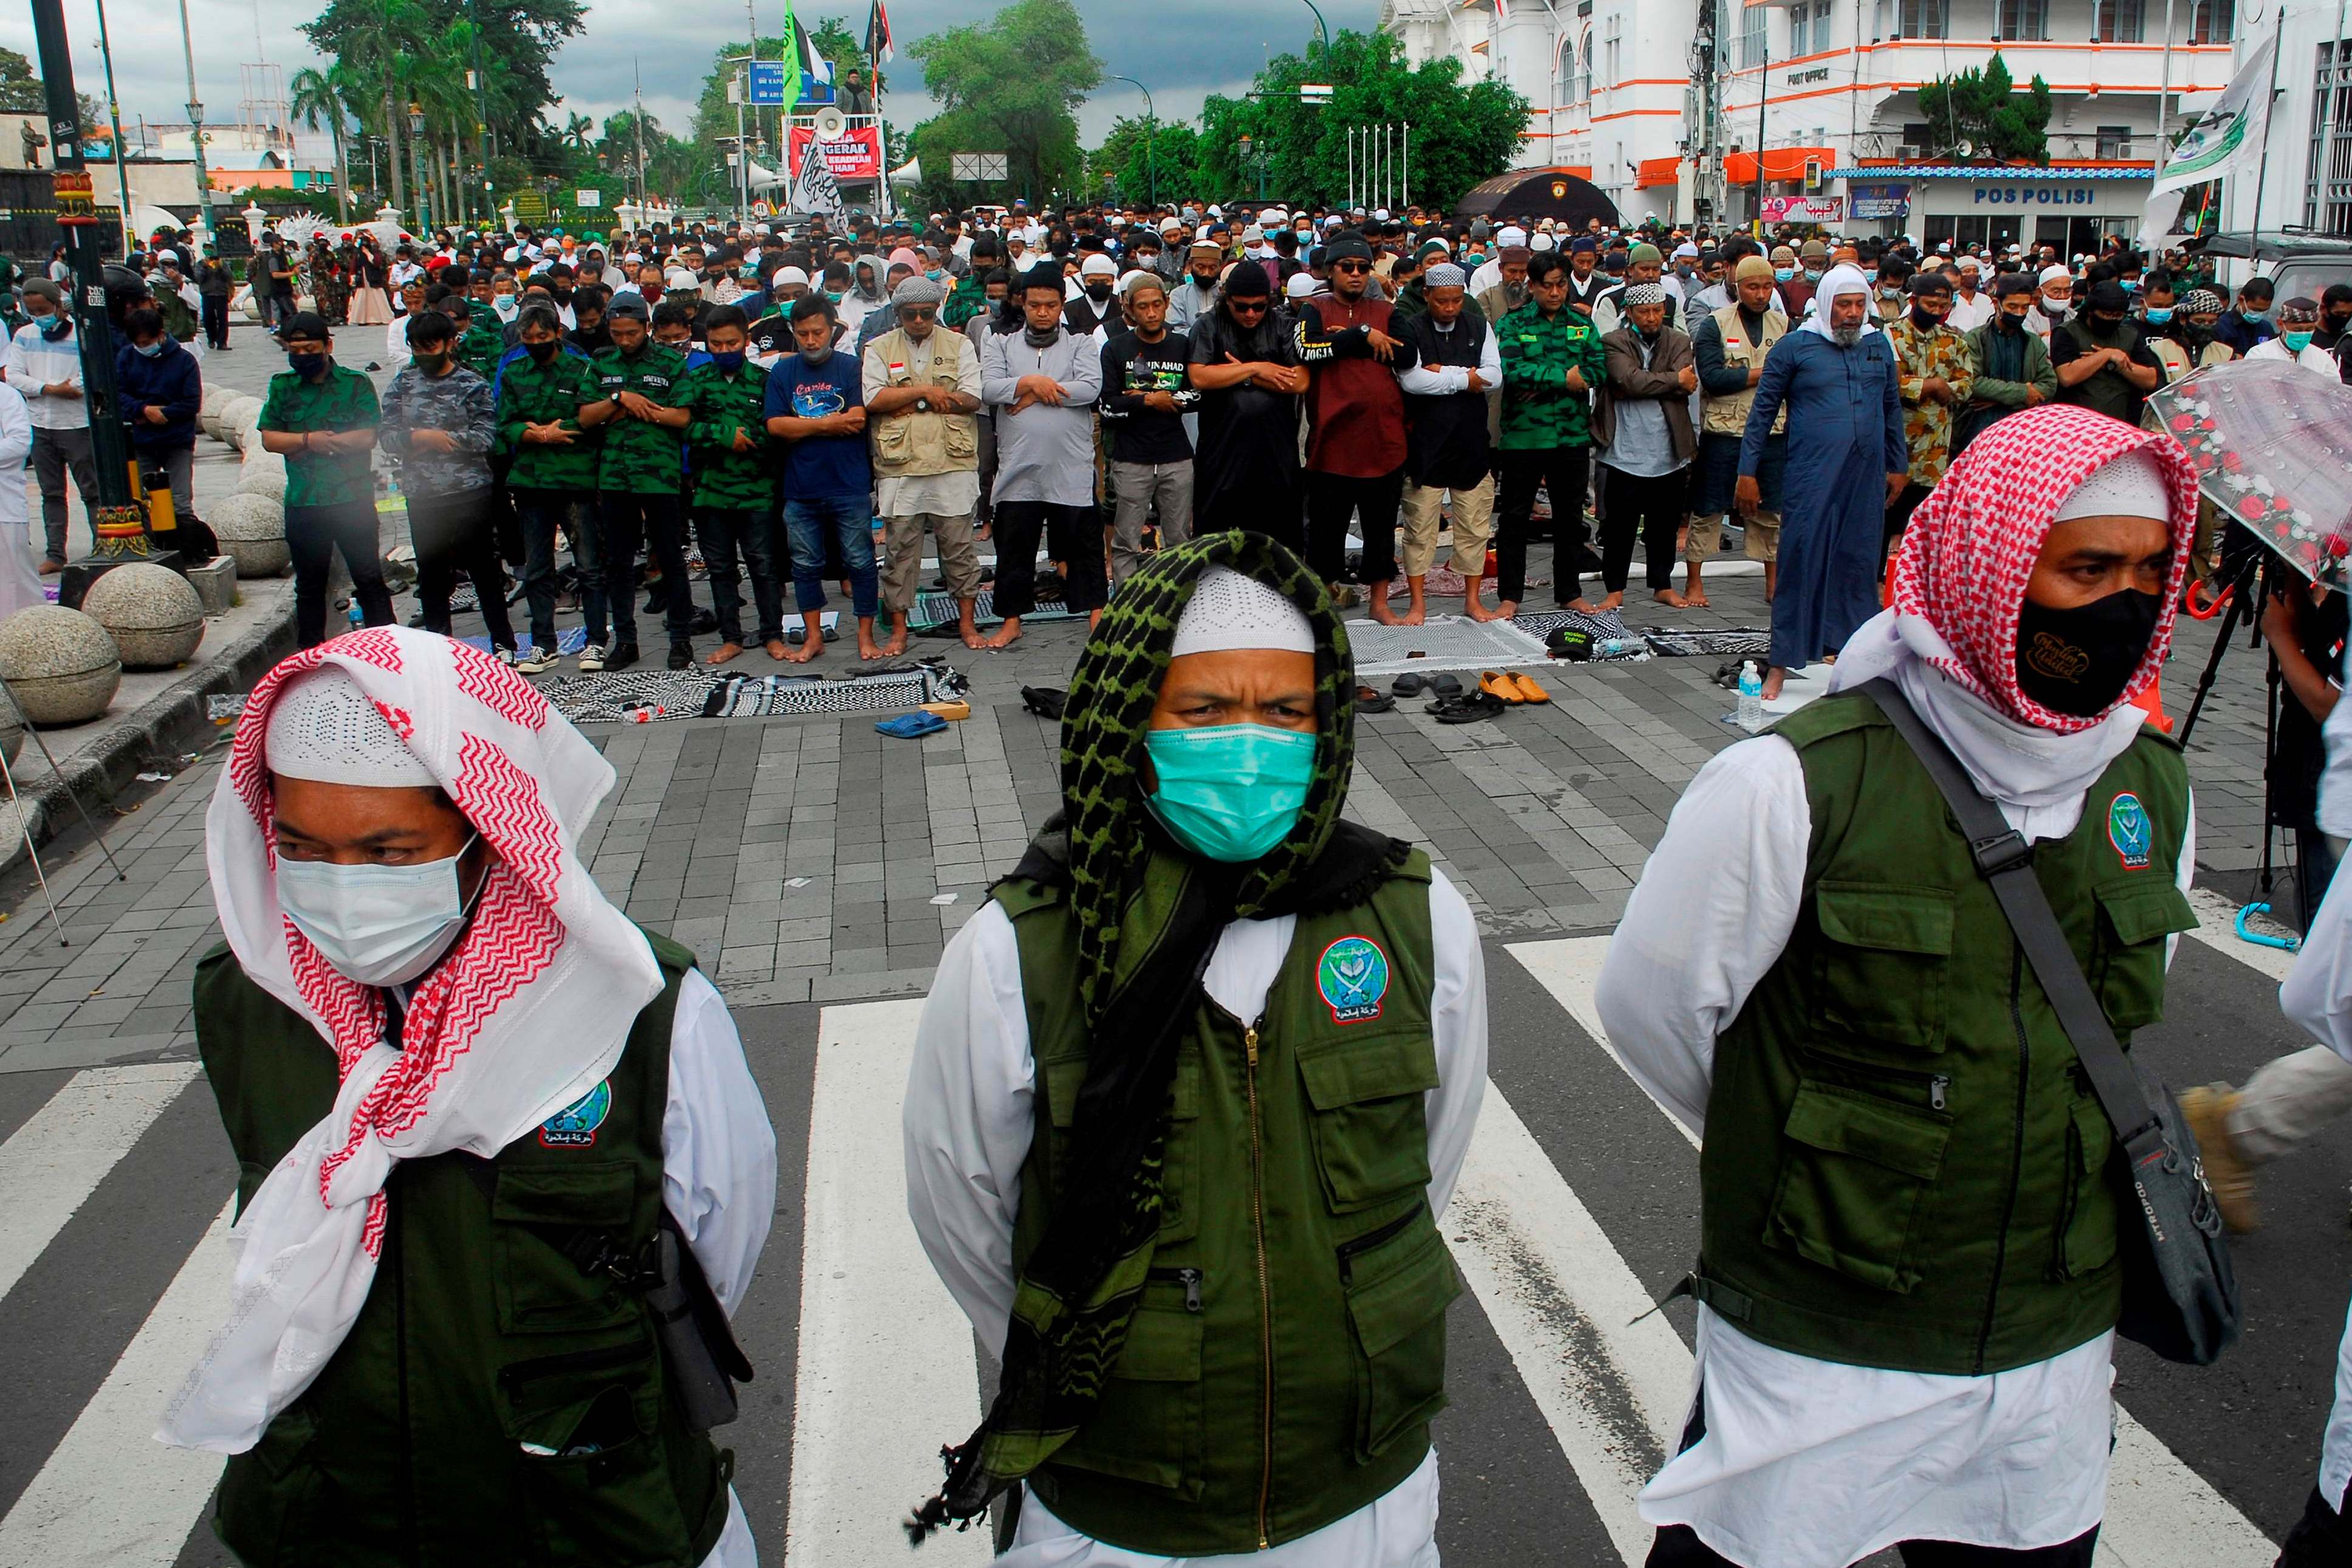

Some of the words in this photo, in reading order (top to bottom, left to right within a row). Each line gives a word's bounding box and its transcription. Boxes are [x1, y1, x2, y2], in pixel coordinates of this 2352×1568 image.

[1787, 72, 1804, 85] POST
[1805, 67, 1829, 83] OFFICE
[828, 155, 871, 165] KEADILAN
[1975, 188, 2016, 204] POS
[2022, 188, 2094, 204] POLISI
[1798, 201, 1838, 211] MONEY
[1783, 211, 1839, 221] CHANGER
[2089, 218, 2100, 227] 17
[1304, 347, 1333, 361] JOGJA
[1161, 362, 1184, 372] AHAD
[1565, 636, 1584, 644] fighter
[2034, 632, 2079, 667] Muslim
